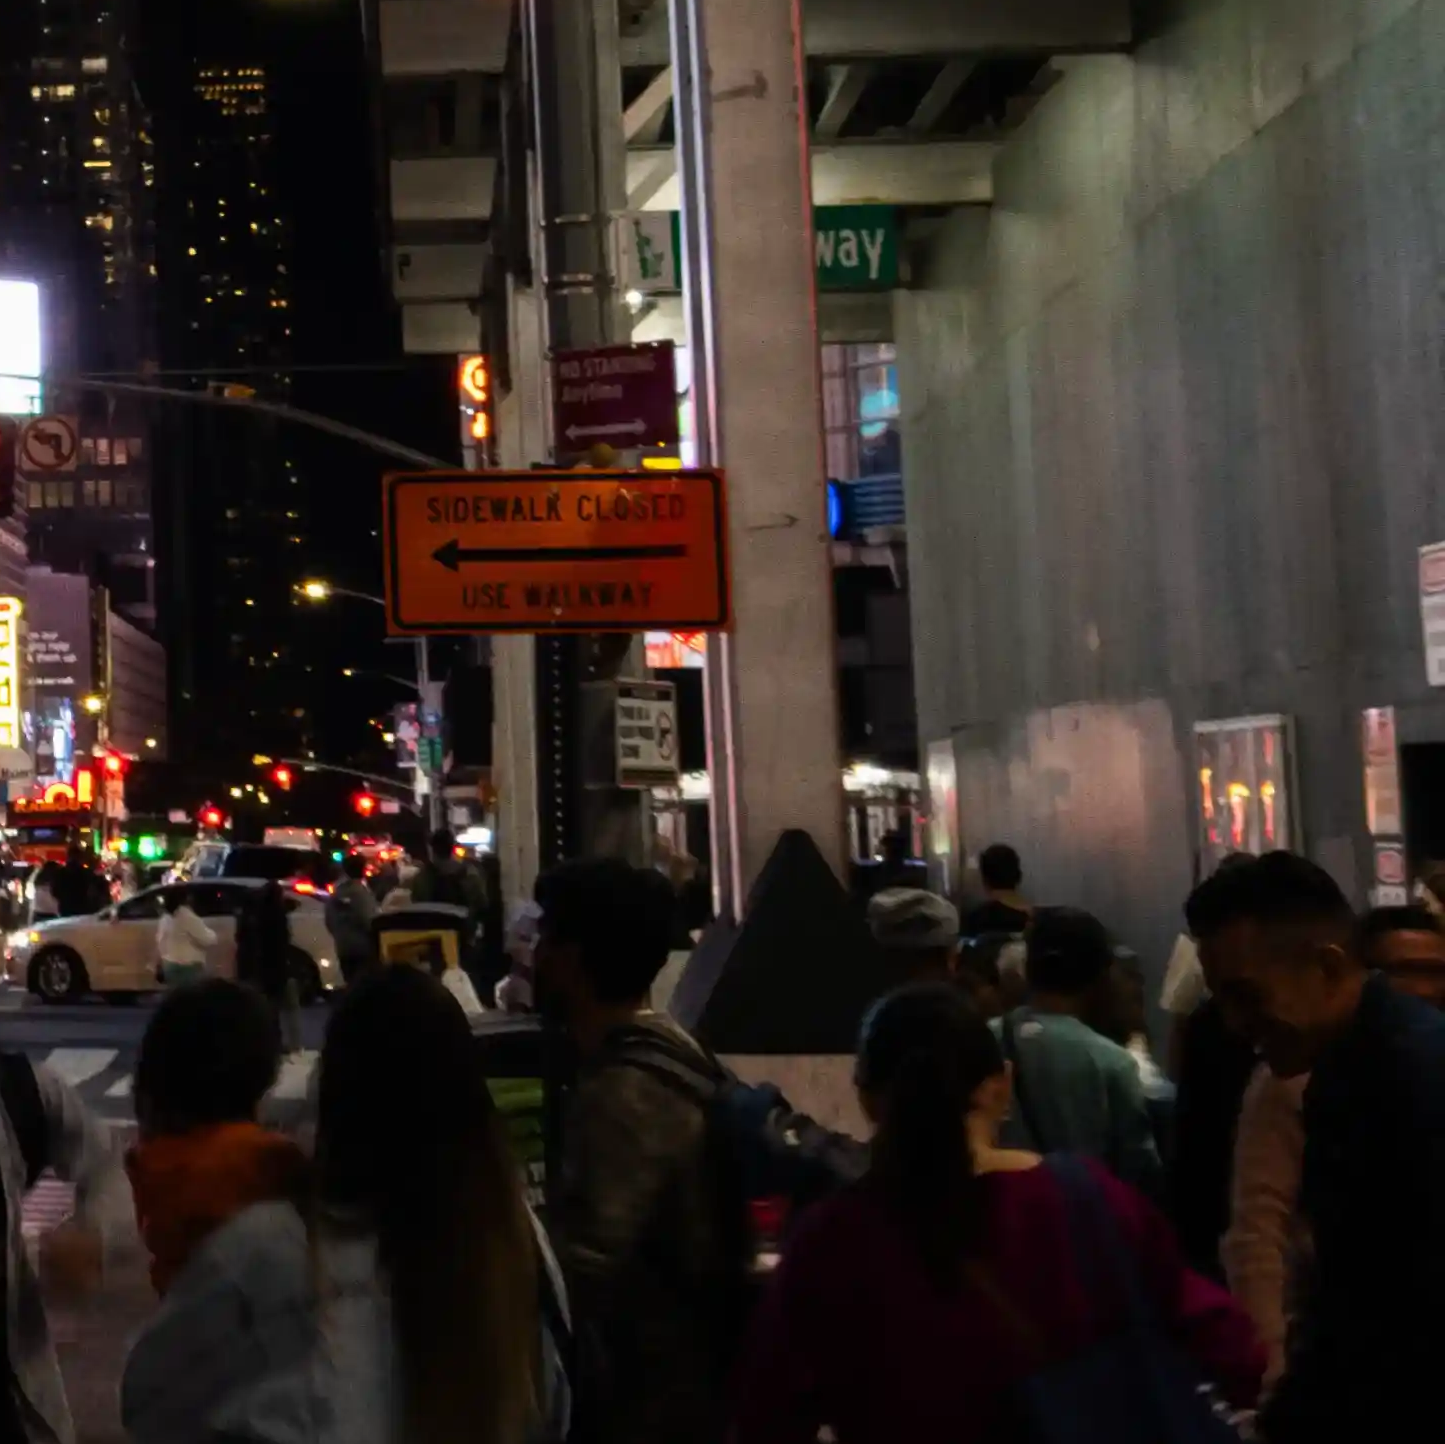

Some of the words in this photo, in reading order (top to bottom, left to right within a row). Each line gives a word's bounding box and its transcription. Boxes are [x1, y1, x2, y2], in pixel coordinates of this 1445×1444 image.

[426, 492, 563, 524] SIDEWALK
[576, 493, 687, 523] CLOSED
[462, 581, 510, 611] USE
[523, 581, 655, 609] WALKWAY
